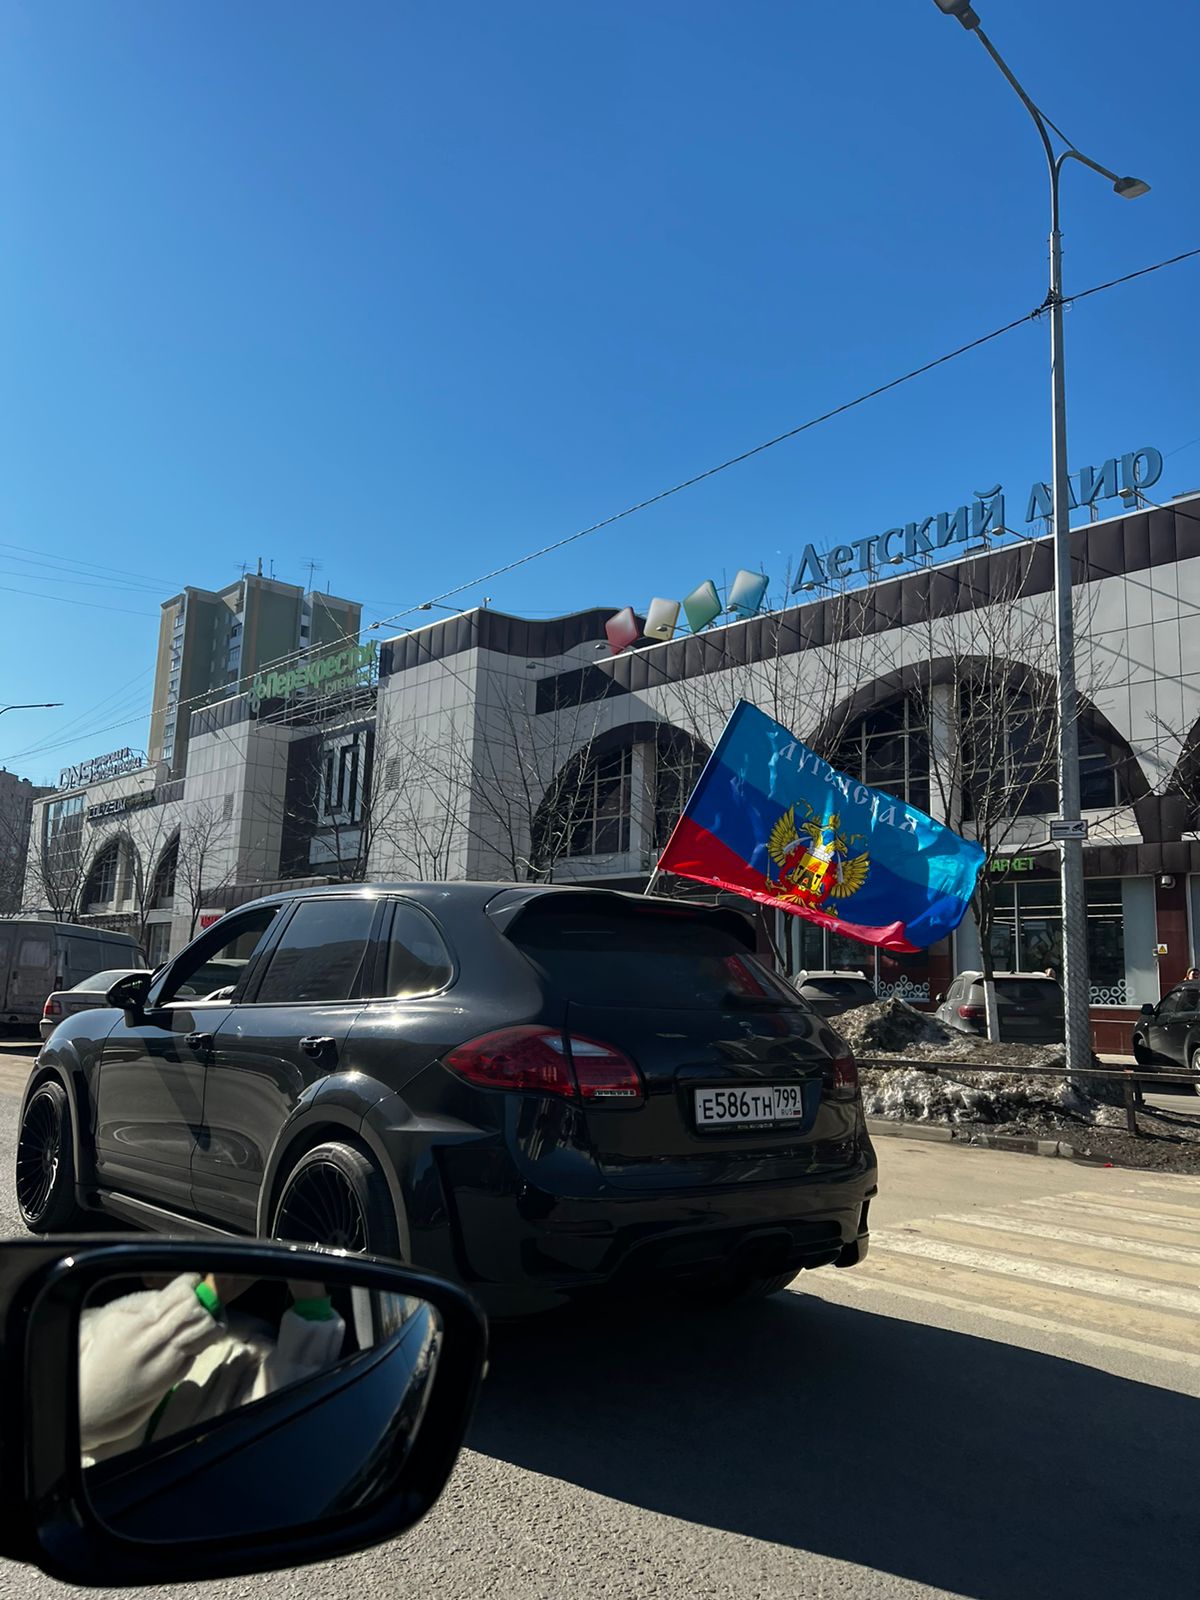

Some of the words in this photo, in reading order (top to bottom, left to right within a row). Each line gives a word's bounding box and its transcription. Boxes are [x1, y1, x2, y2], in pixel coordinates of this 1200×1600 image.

[791, 483, 1005, 595] Детский
[59, 758, 94, 791] DNS
[774, 1088, 797, 1108] 799
